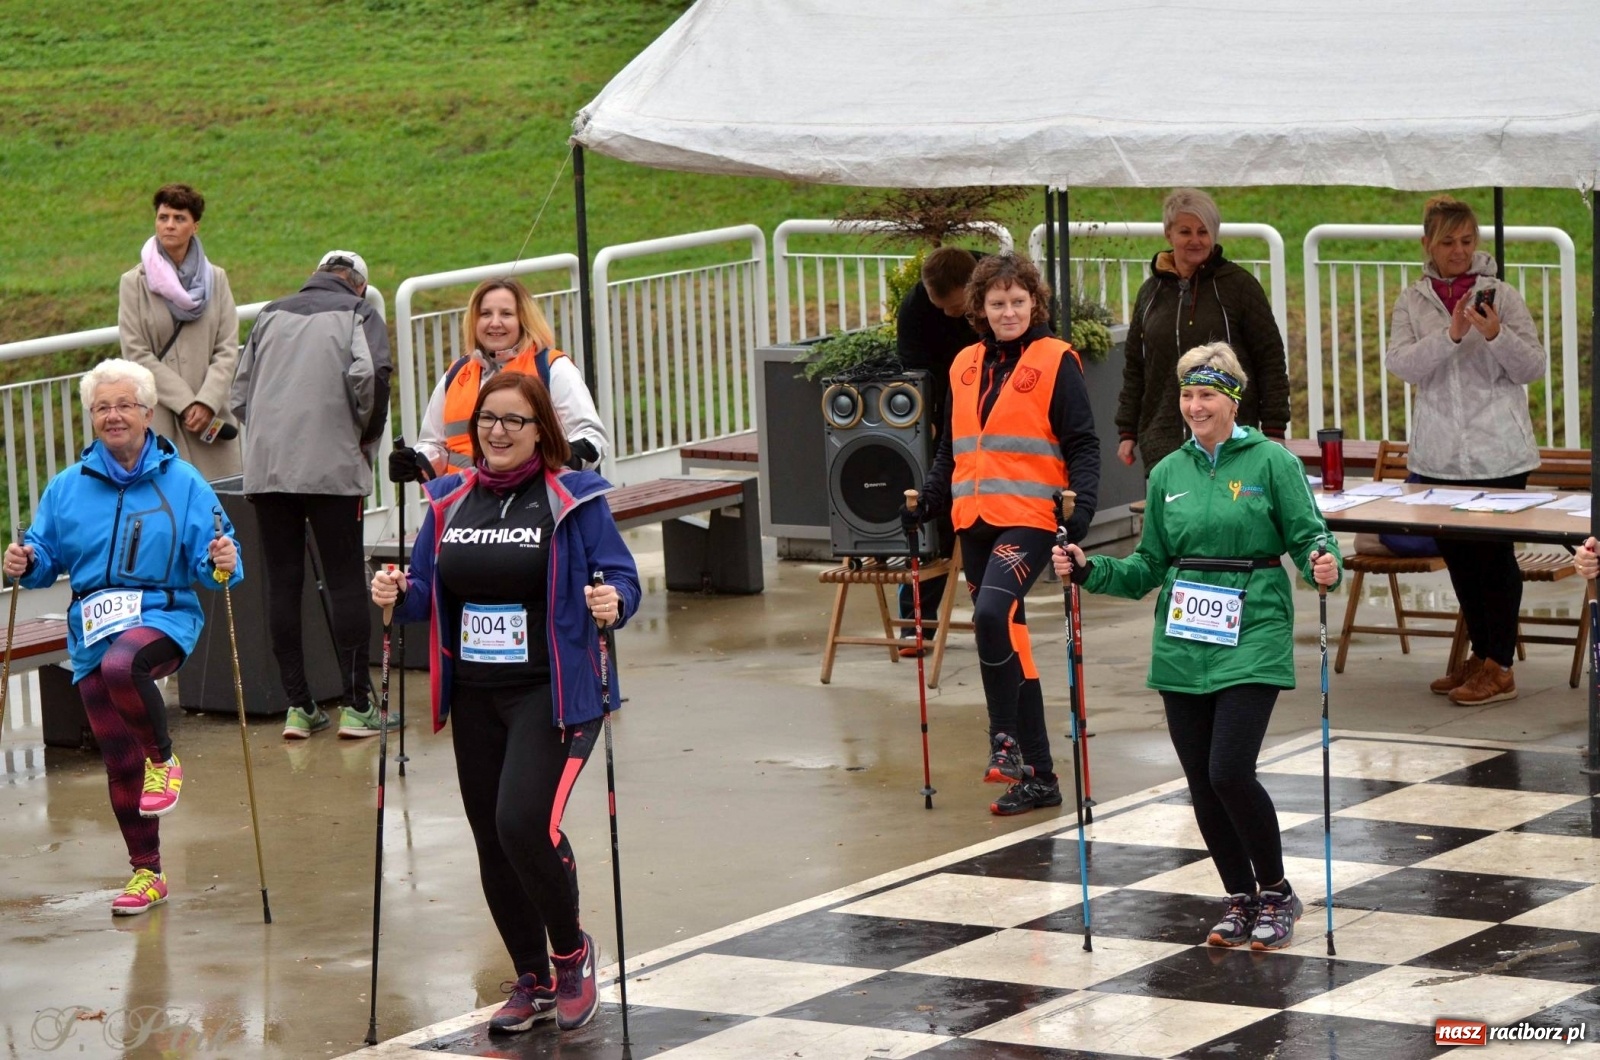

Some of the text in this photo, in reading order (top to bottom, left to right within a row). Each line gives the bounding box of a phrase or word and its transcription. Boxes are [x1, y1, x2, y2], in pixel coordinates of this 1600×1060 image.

[442, 527, 542, 544] DECATHLON
[93, 596, 122, 618] 003
[1186, 596, 1223, 618] 009
[471, 615, 506, 635] 004
